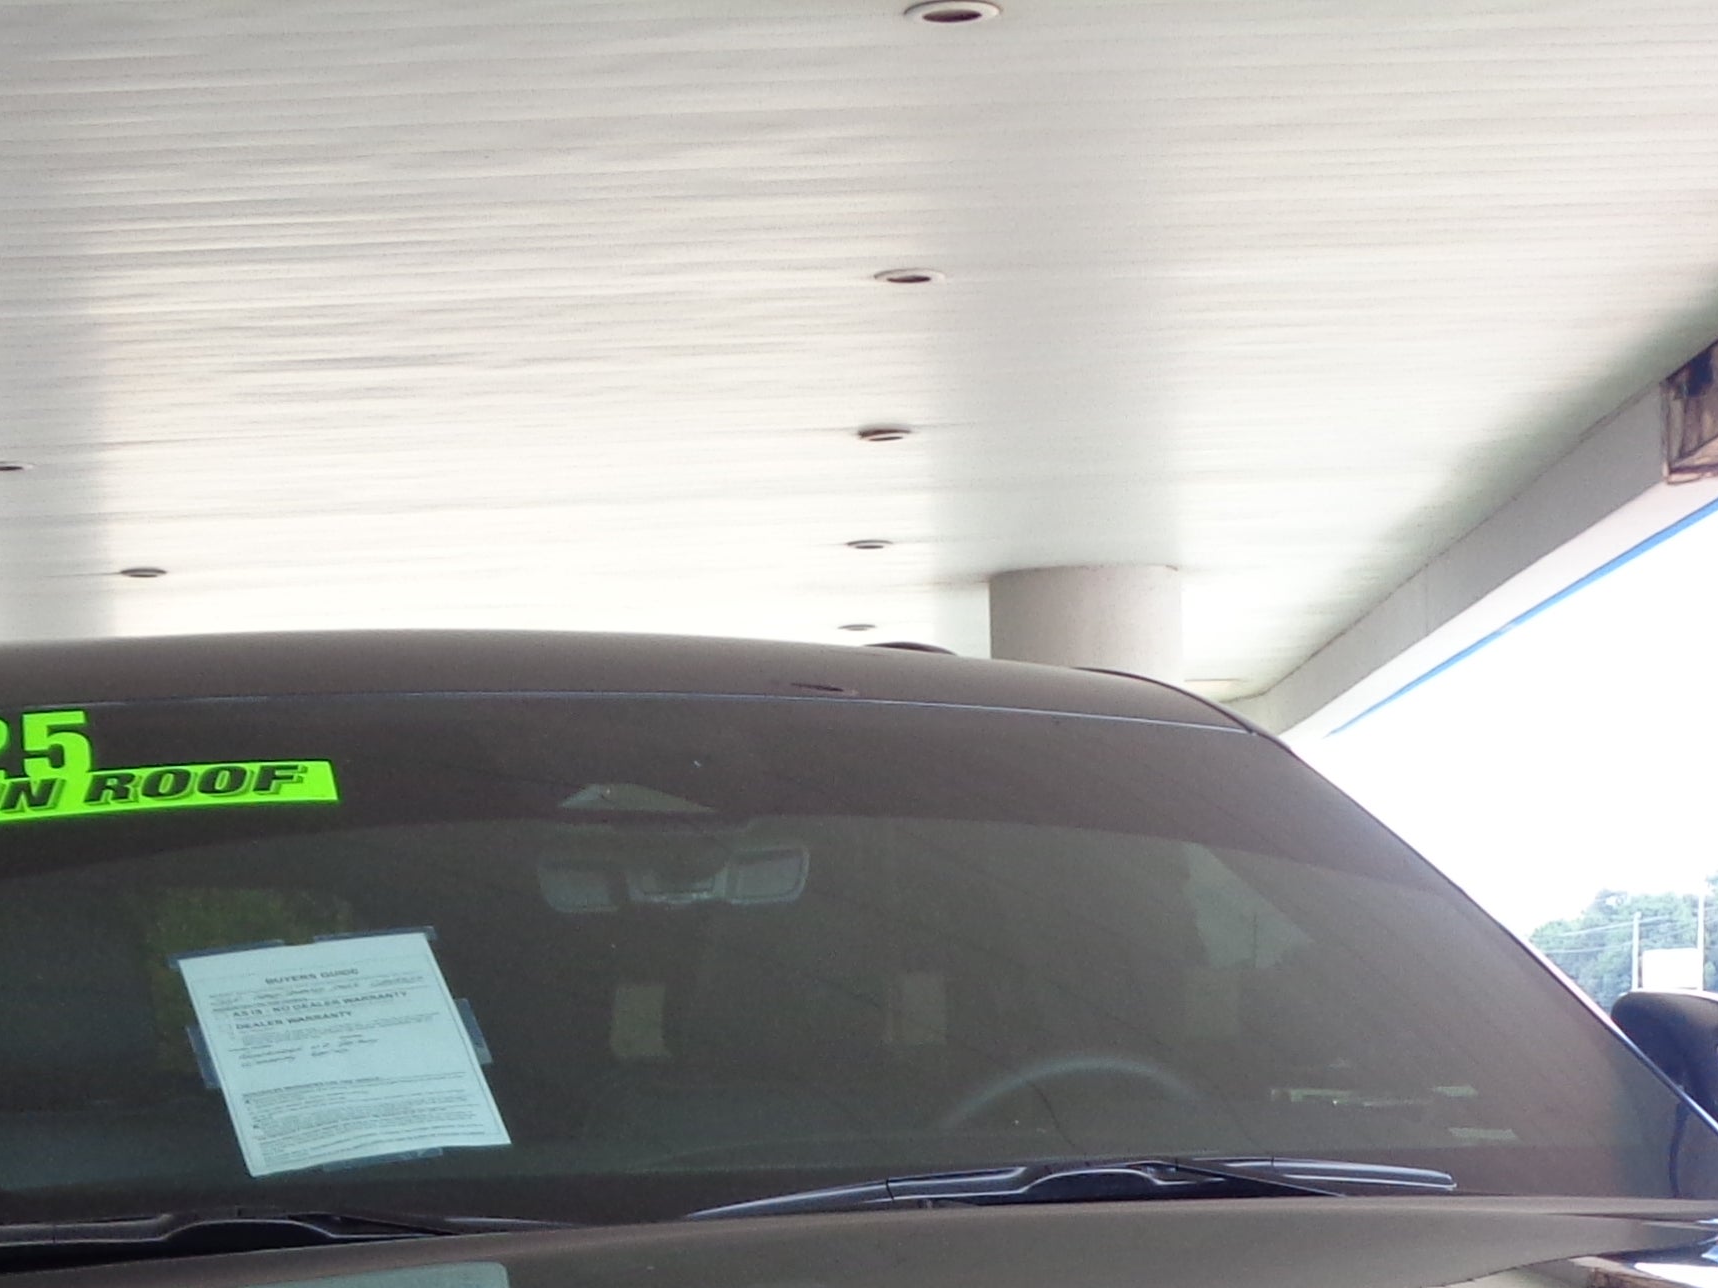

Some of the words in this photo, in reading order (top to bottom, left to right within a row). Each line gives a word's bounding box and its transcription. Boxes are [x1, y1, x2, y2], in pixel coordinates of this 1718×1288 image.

[84, 763, 307, 806] ROOF
[265, 973, 317, 984] BUYERS
[320, 968, 359, 978] GUIDE
[291, 999, 340, 1010] DEALER
[342, 991, 406, 1004] WARRANTY
[236, 1019, 283, 1030] DEALER
[287, 1010, 351, 1024] WARRANTY
